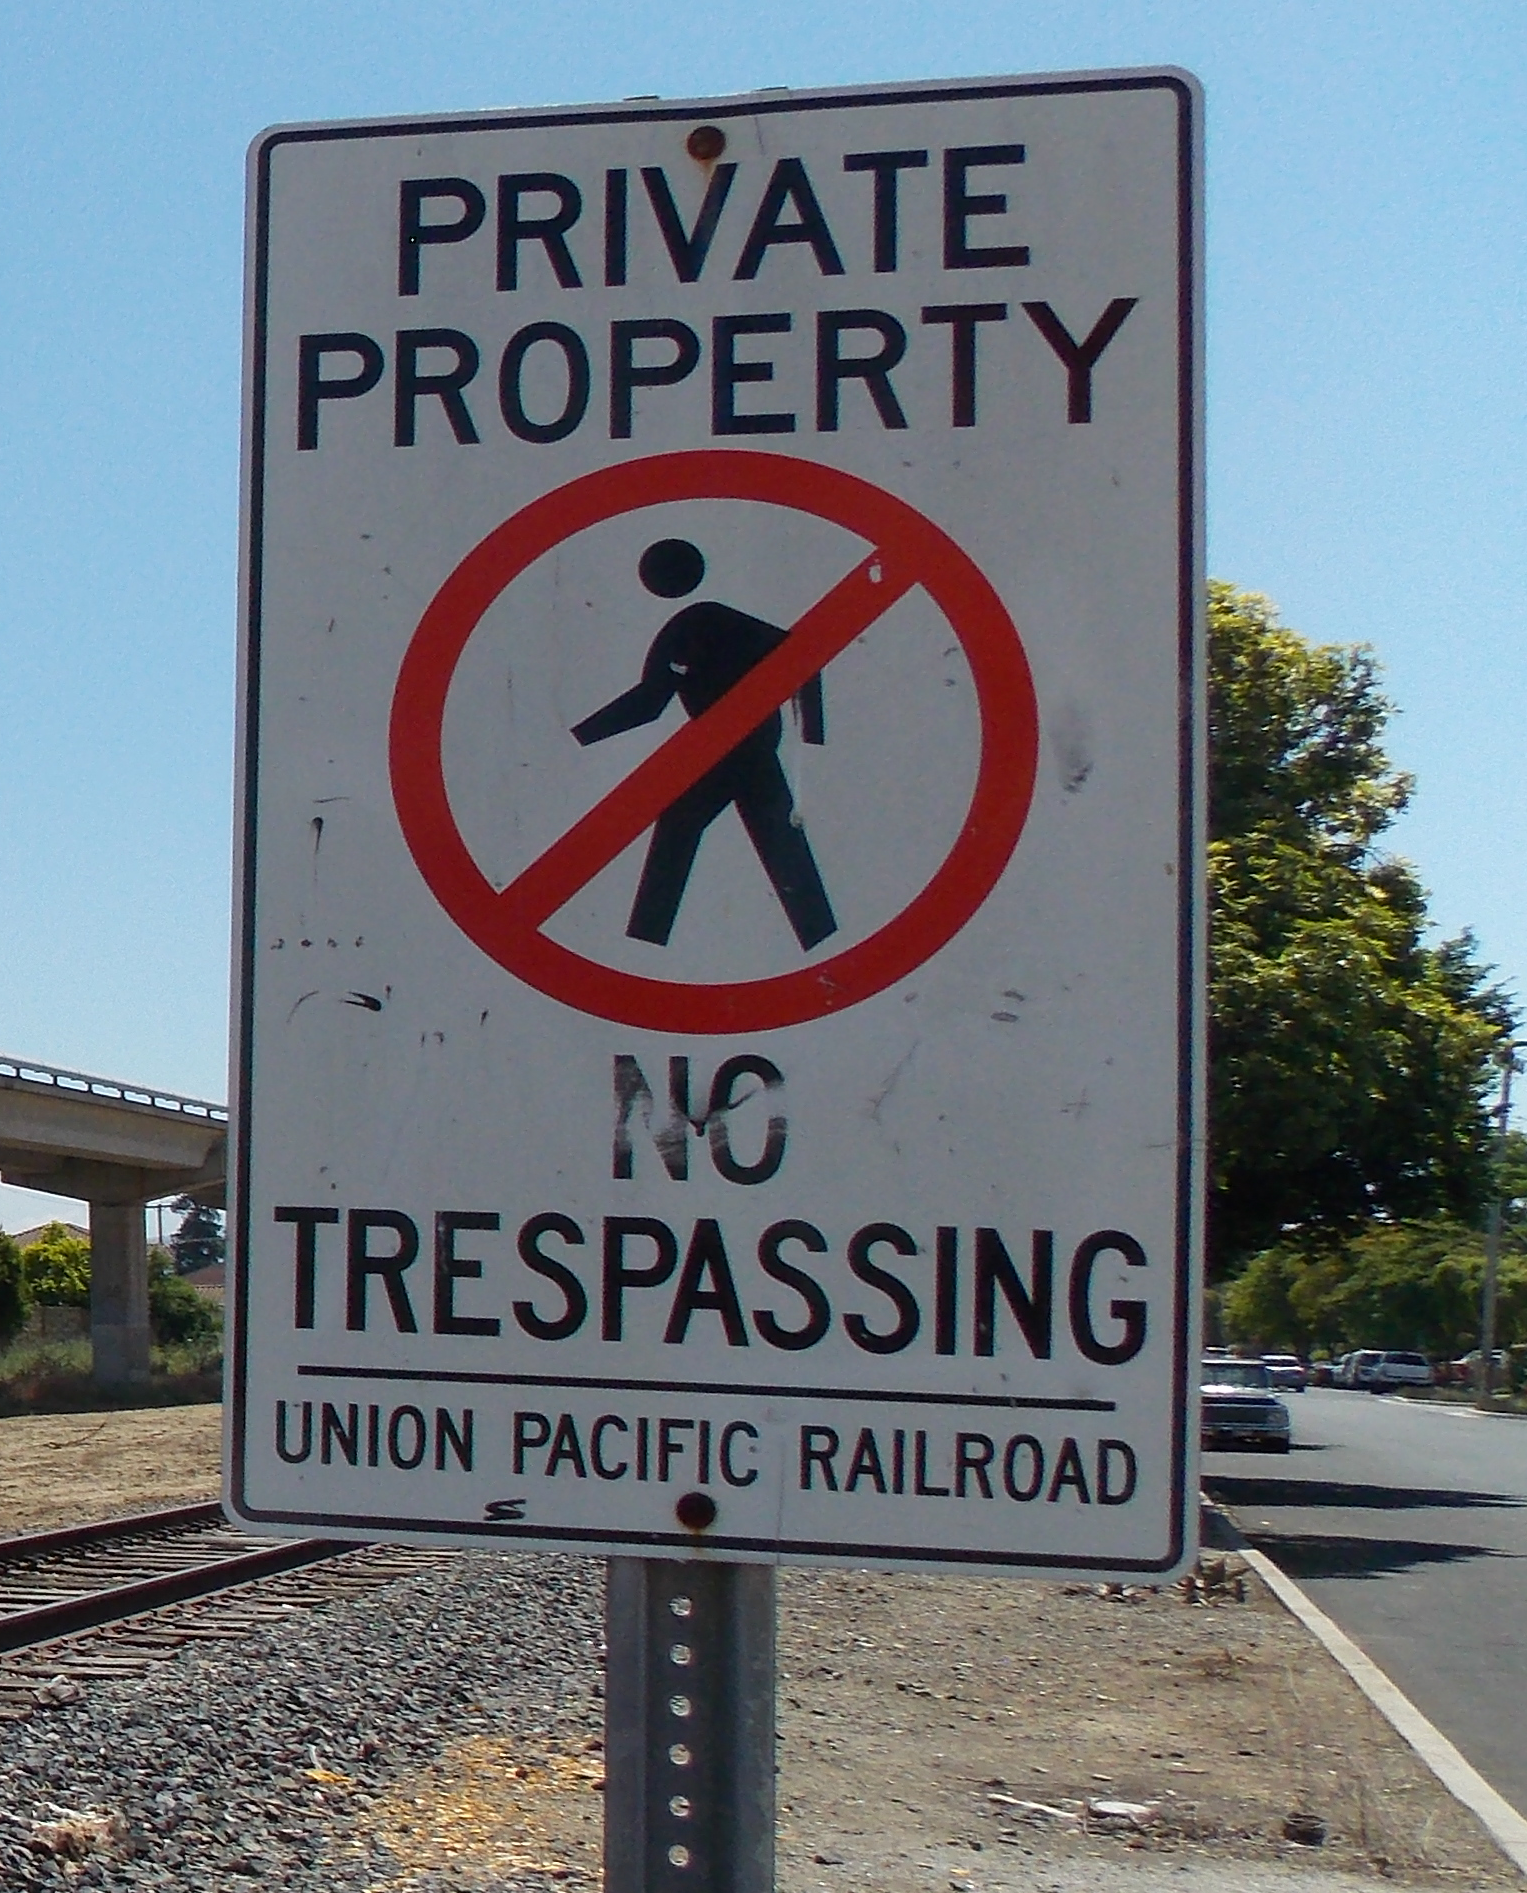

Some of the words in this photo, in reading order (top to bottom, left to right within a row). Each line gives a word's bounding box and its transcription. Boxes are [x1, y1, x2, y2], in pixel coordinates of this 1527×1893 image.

[398, 143, 1031, 296] PRIVATE
[297, 297, 1140, 451] PROPERTY
[612, 1054, 788, 1186] NO
[273, 1205, 1148, 1366] TRESPASSING
[275, 1400, 474, 1474] UNION
[512, 1411, 759, 1488] PACIFIC
[800, 1424, 1138, 1506] RAILROAD
